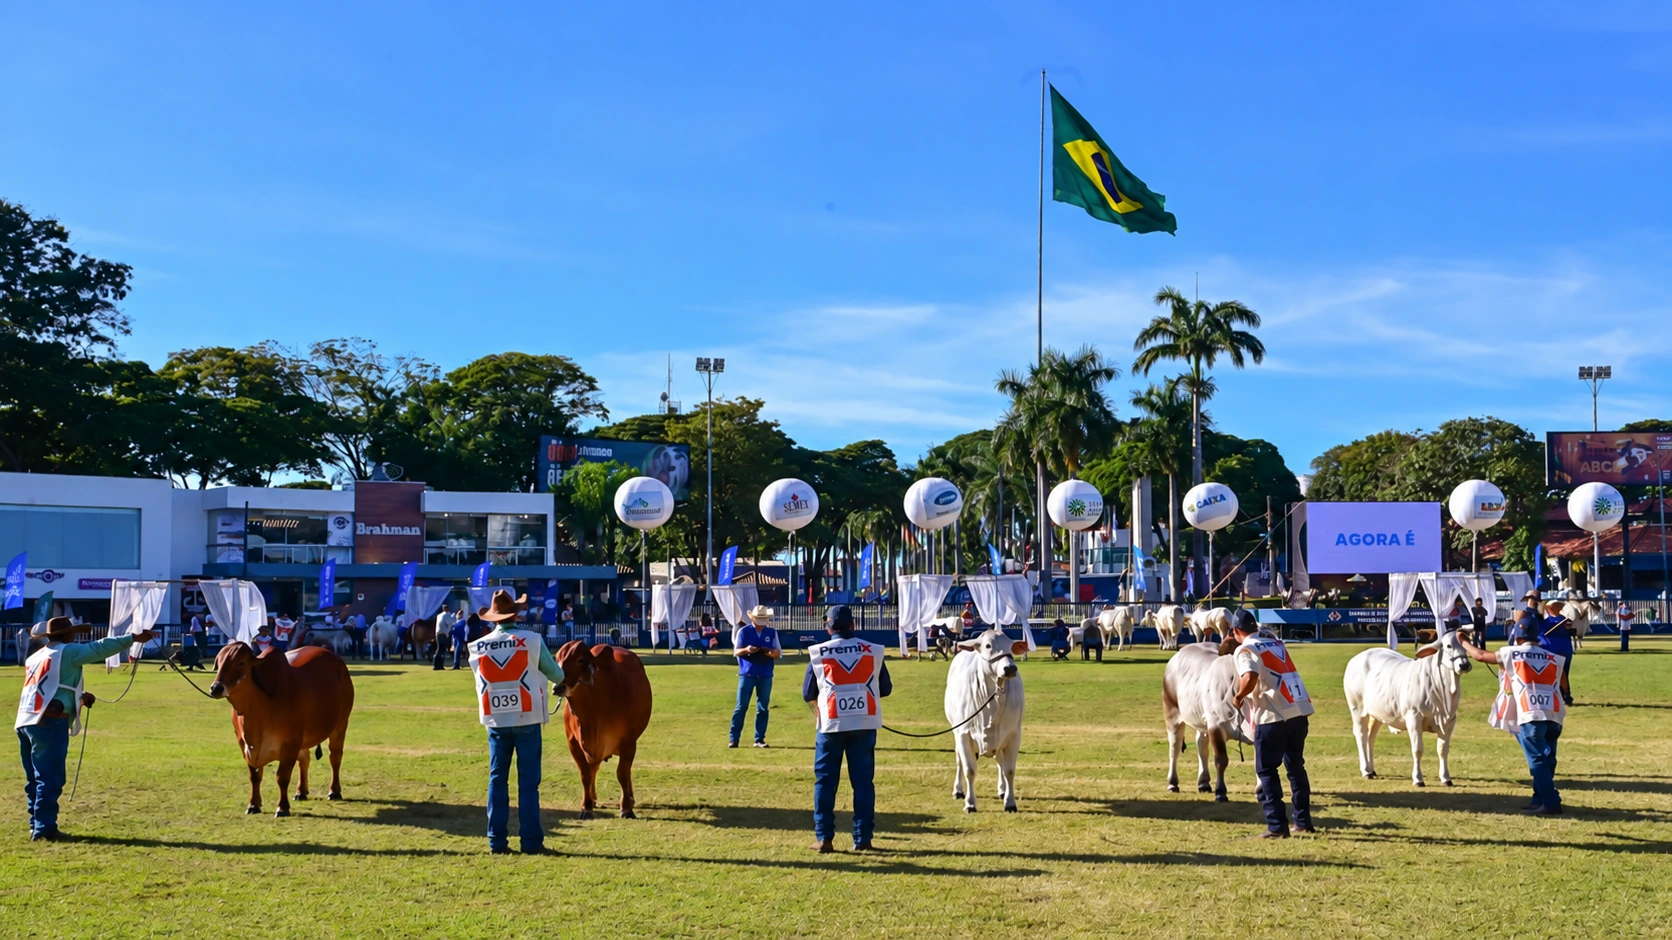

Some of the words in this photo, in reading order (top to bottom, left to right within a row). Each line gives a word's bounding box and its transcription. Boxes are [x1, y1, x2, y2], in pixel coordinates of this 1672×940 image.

[1196, 493, 1227, 509] CAIXA
[356, 522, 421, 536] Brahman
[1335, 533, 1401, 546] AGORA
[1405, 529, 1415, 546] É
[477, 635, 527, 652] Premix
[820, 642, 872, 656] Premix
[491, 694, 519, 708] 039
[838, 697, 865, 711] 026
[1529, 694, 1550, 706] 007
